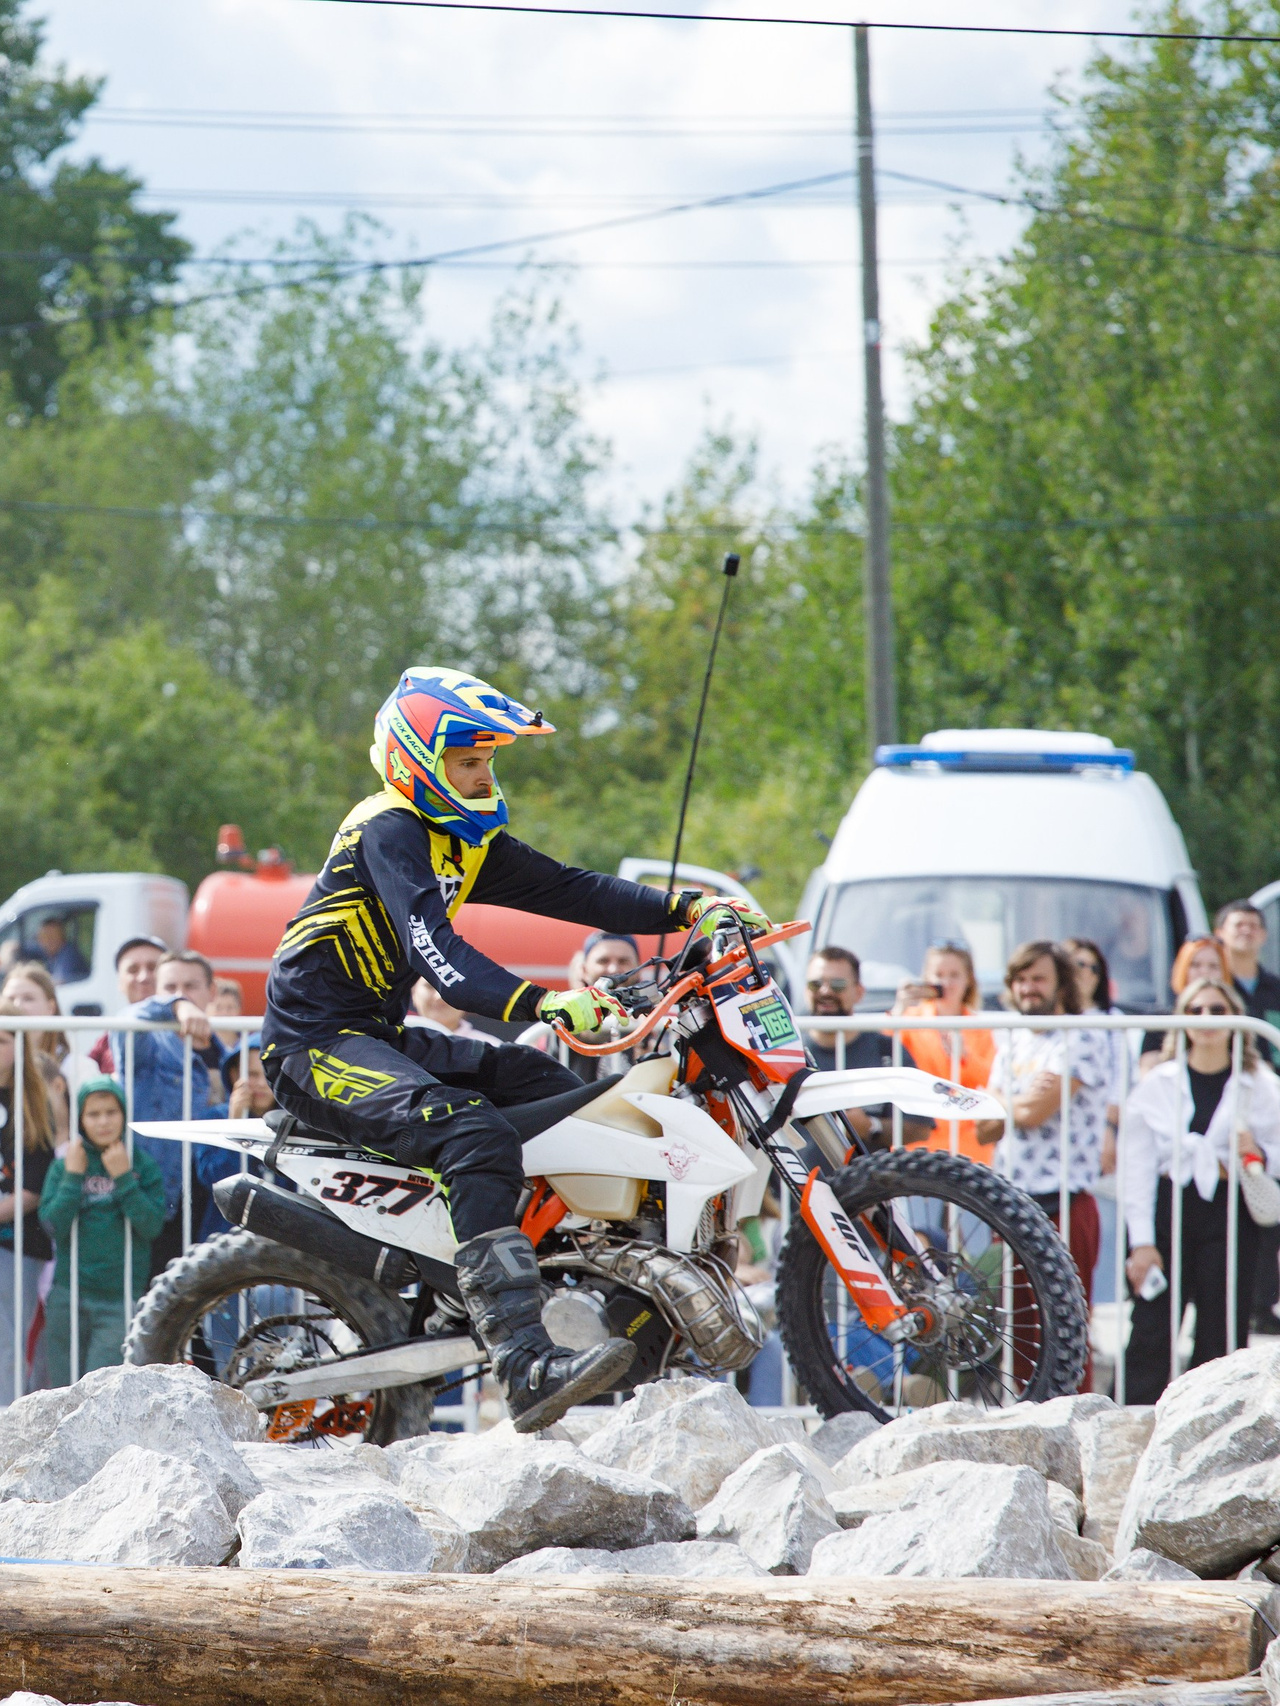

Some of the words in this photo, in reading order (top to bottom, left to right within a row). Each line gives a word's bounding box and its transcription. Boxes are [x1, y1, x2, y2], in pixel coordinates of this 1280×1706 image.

[393, 716, 407, 734] FOX
[404, 734, 434, 765] RACING
[760, 1008, 794, 1039] 166
[344, 1151, 384, 1163] EXC
[320, 1171, 435, 1217] 377
